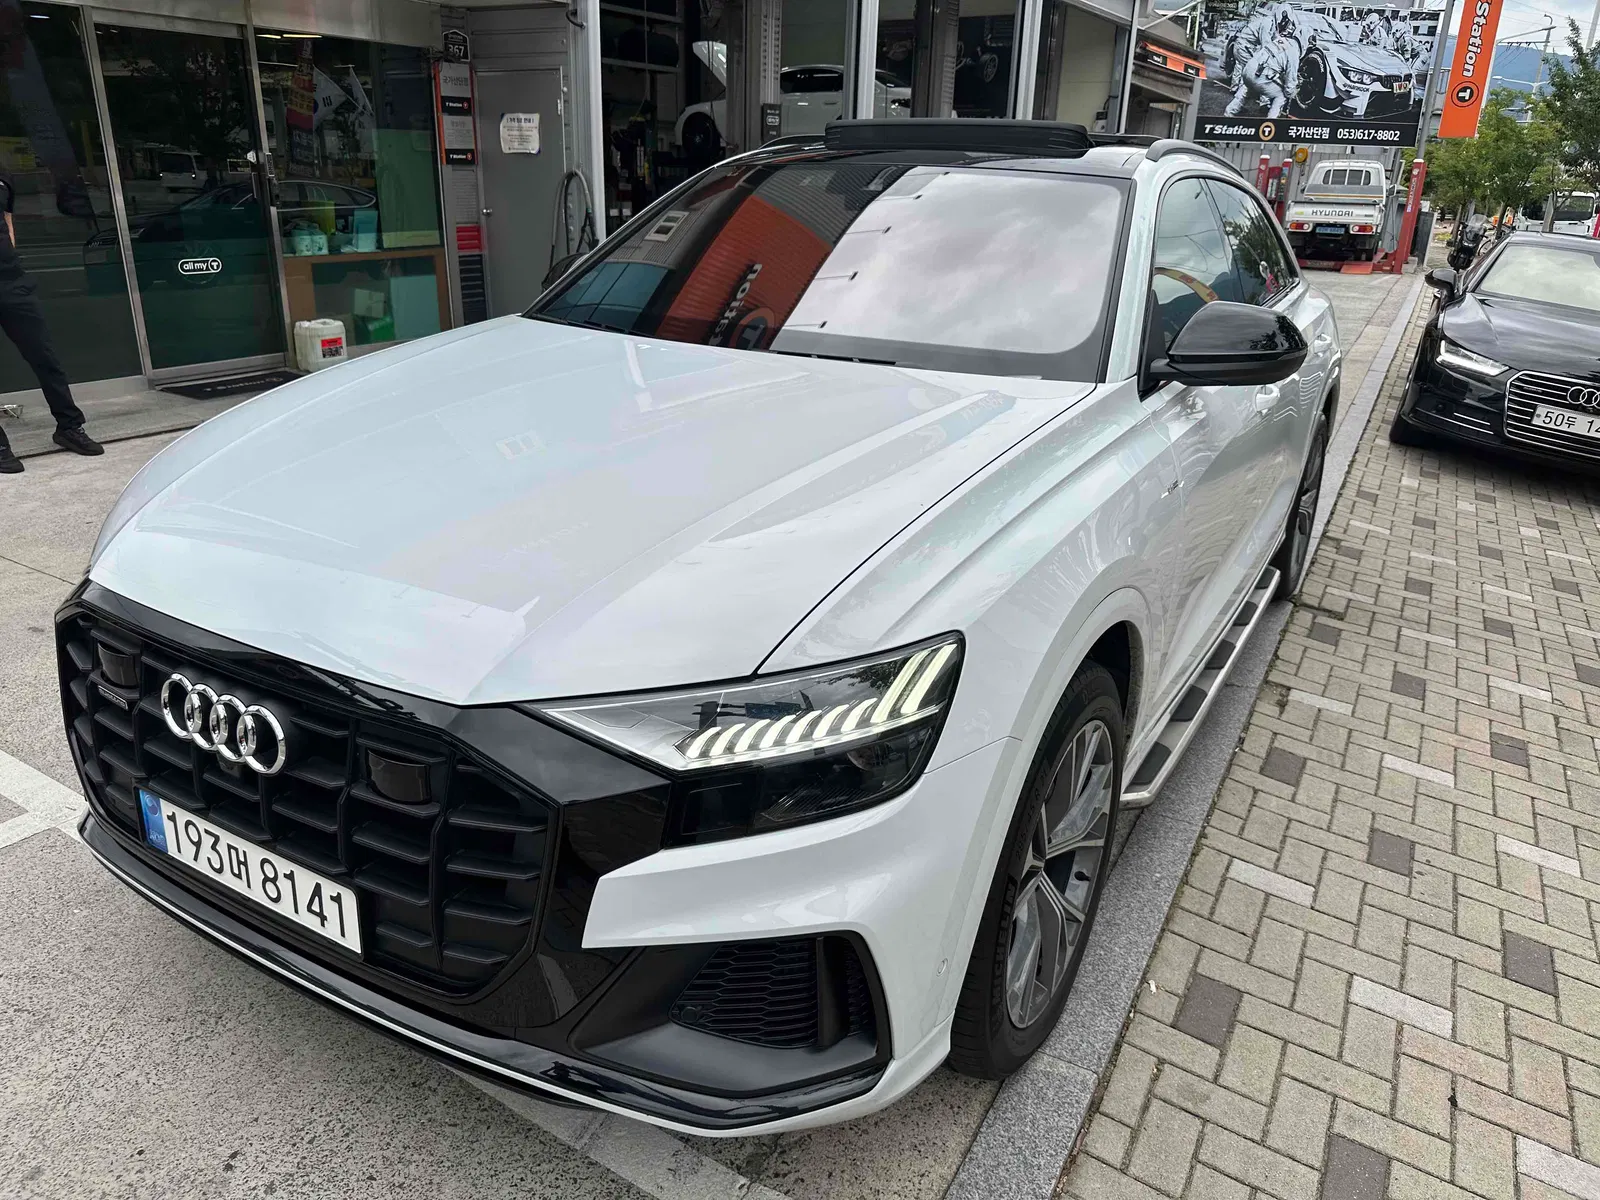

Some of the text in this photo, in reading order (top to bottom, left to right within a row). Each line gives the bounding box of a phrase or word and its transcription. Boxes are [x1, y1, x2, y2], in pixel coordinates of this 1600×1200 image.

[1462, 0, 1490, 77] Station
[1287, 126, 1330, 139] 국가산단점
[1337, 128, 1400, 141] 053)617-8802
[1311, 209, 1354, 217] HYUNDAI
[1543, 411, 1577, 429] 50두
[166, 811, 346, 938] 193머 8141
[991, 882, 1016, 1006] MICHELIN
